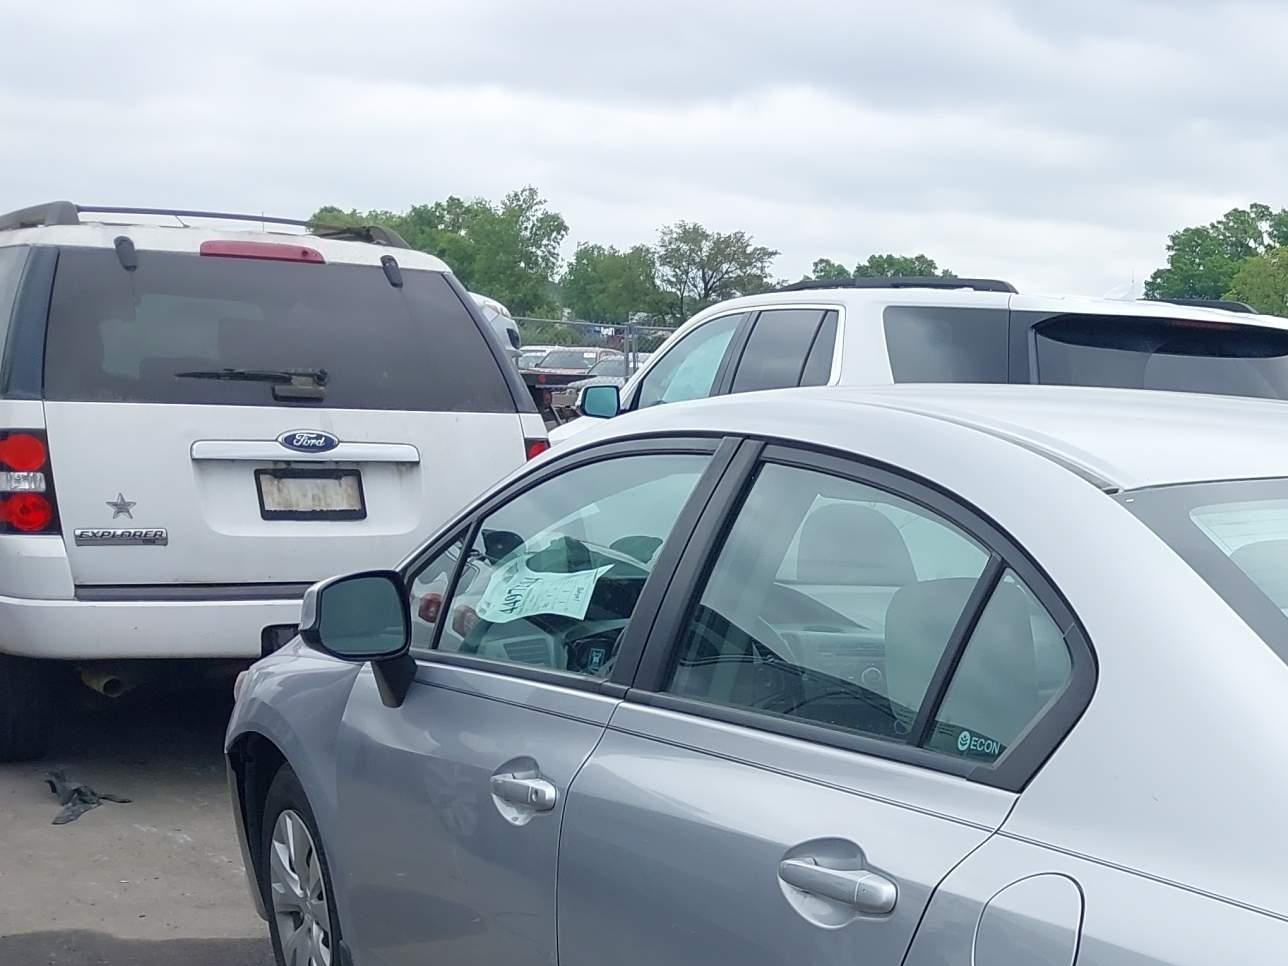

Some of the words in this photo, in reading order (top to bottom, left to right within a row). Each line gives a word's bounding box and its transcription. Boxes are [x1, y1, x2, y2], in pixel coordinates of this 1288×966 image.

[293, 433, 326, 447] Ford
[79, 530, 164, 539] EXPLORER
[970, 736, 1000, 755] ECON
